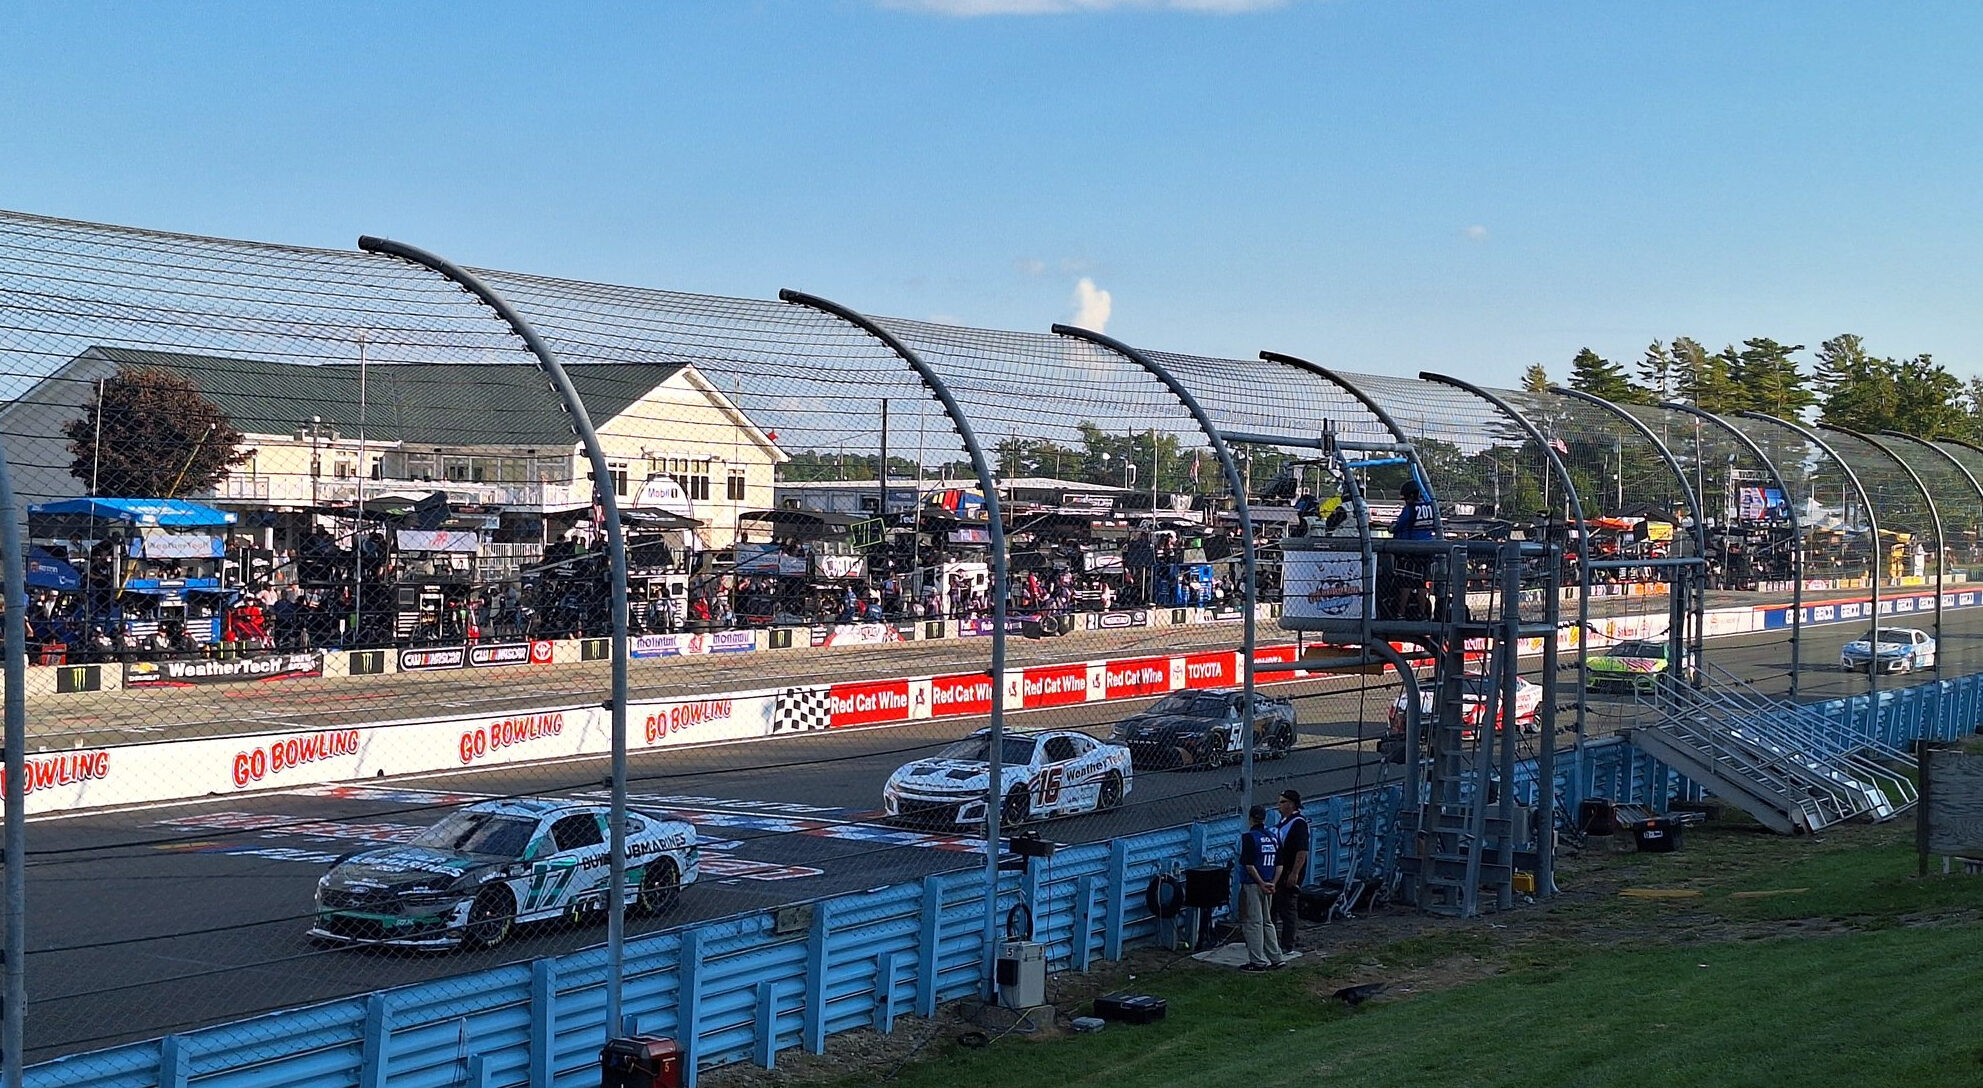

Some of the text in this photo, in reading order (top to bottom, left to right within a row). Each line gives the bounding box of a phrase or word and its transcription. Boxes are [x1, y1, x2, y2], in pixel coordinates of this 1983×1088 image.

[648, 488, 670, 498] Mobil
[1415, 505, 1433, 520] 201
[168, 659, 283, 678] WeatherTech
[1106, 667, 1163, 688] Red Cat Wine
[1188, 662, 1222, 679] TOYOTA
[933, 685, 953, 704] Red
[955, 684, 974, 702] Cat
[1024, 675, 1086, 696] Red Cat Wine
[831, 690, 907, 714] Red Cat Wine
[645, 699, 732, 743] GO BOWLING
[460, 713, 563, 763] GO BOWLING
[233, 730, 359, 787] GO BOWLING
[1035, 765, 1063, 807] 16
[523, 859, 577, 913] 17
[1007, 947, 1013, 957] 5
